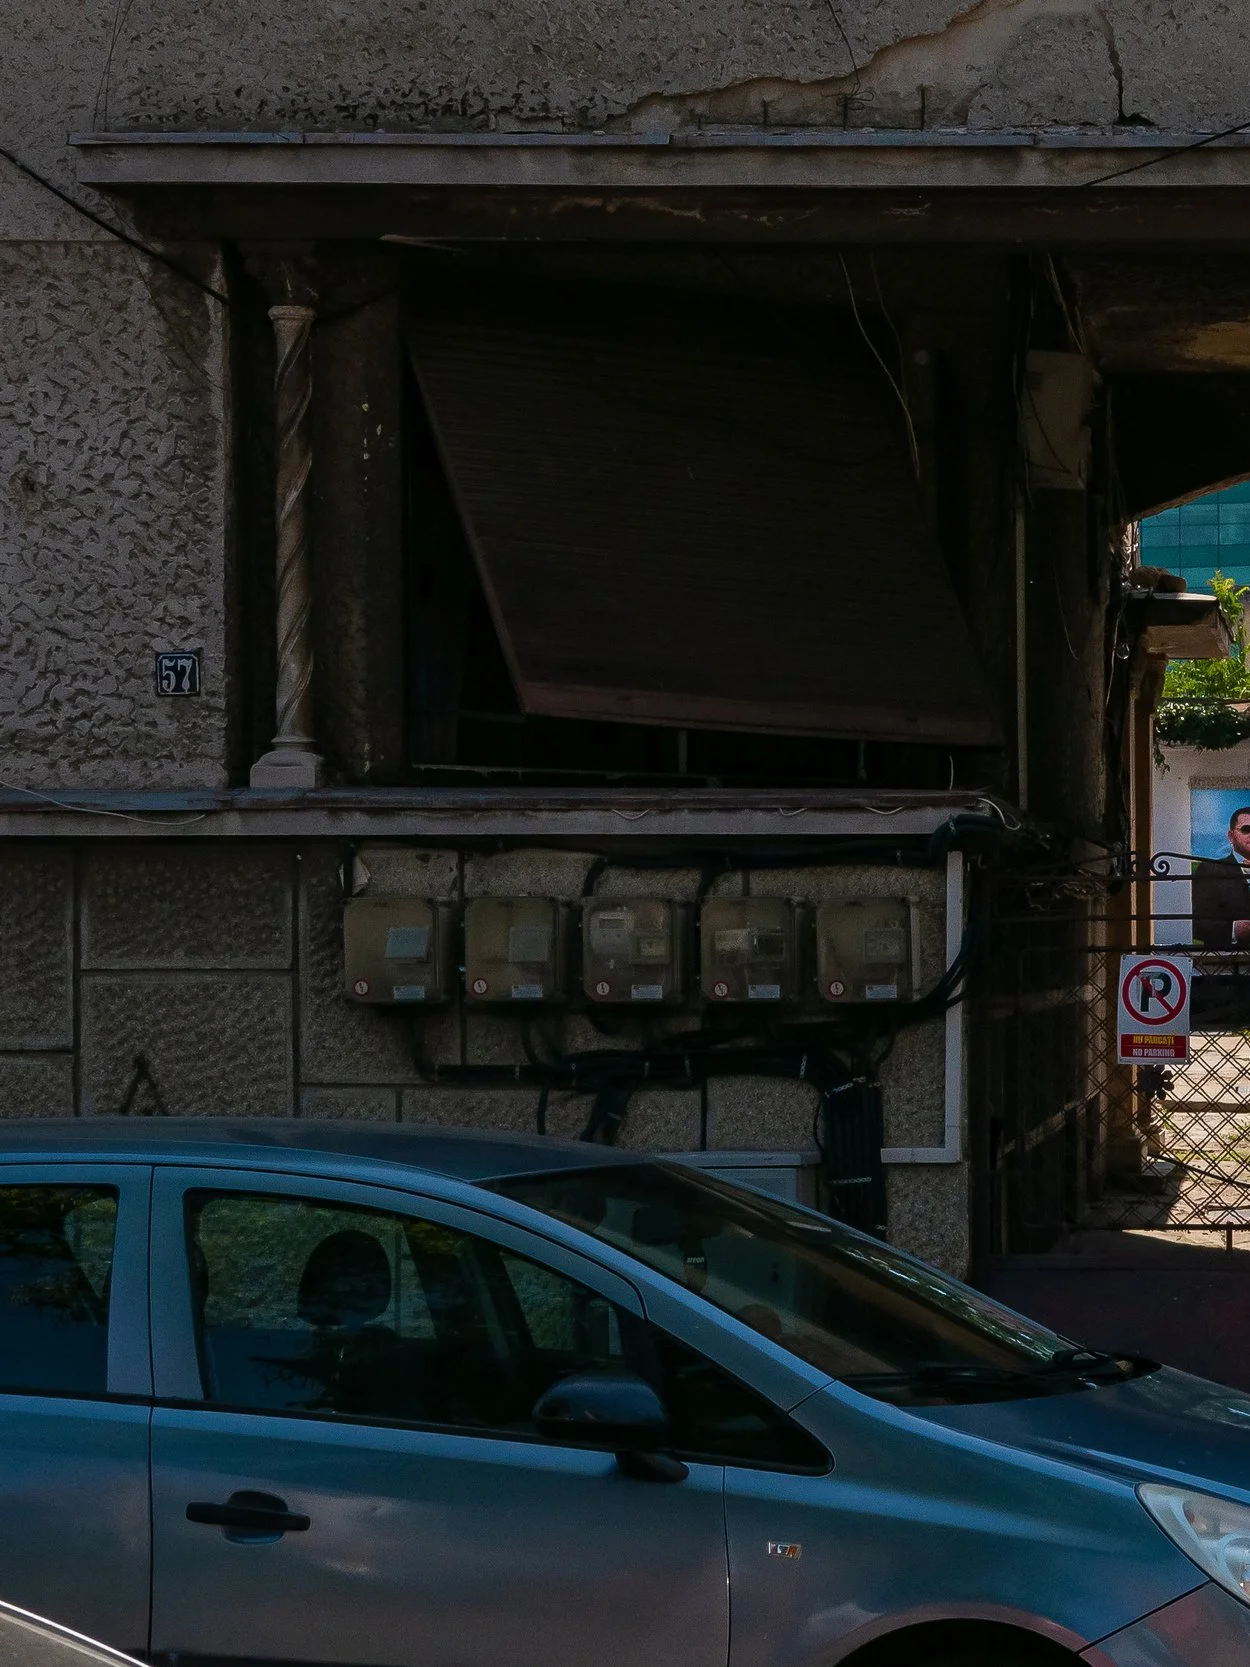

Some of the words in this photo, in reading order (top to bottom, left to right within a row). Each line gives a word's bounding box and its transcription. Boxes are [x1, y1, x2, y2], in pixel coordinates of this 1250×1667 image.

[162, 658, 193, 693] 57
[1133, 1036, 1143, 1044] NU
[1132, 1048, 1142, 1057] NO
[1144, 1048, 1175, 1057] PARKING
